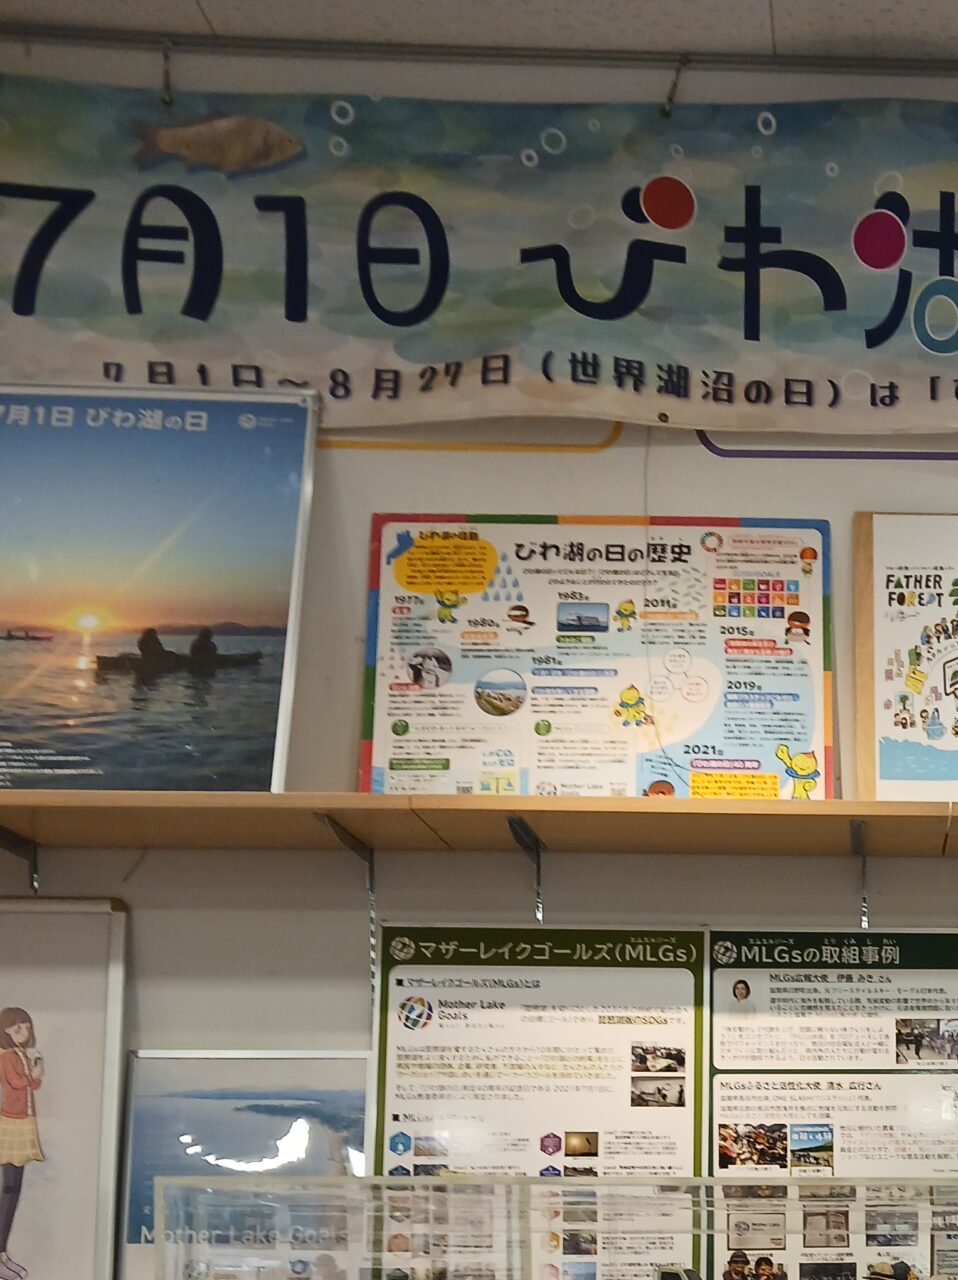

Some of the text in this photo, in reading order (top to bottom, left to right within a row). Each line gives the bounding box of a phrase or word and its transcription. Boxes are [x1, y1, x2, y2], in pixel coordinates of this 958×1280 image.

[0, 182, 451, 328] 7月1日
[0, 404, 208, 431] 月1日 びわ湖の日
[514, 541, 692, 563] びわ湖の日の歴史
[885, 574, 943, 590] FATHER
[741, 944, 900, 965] MLGsの取組事例
